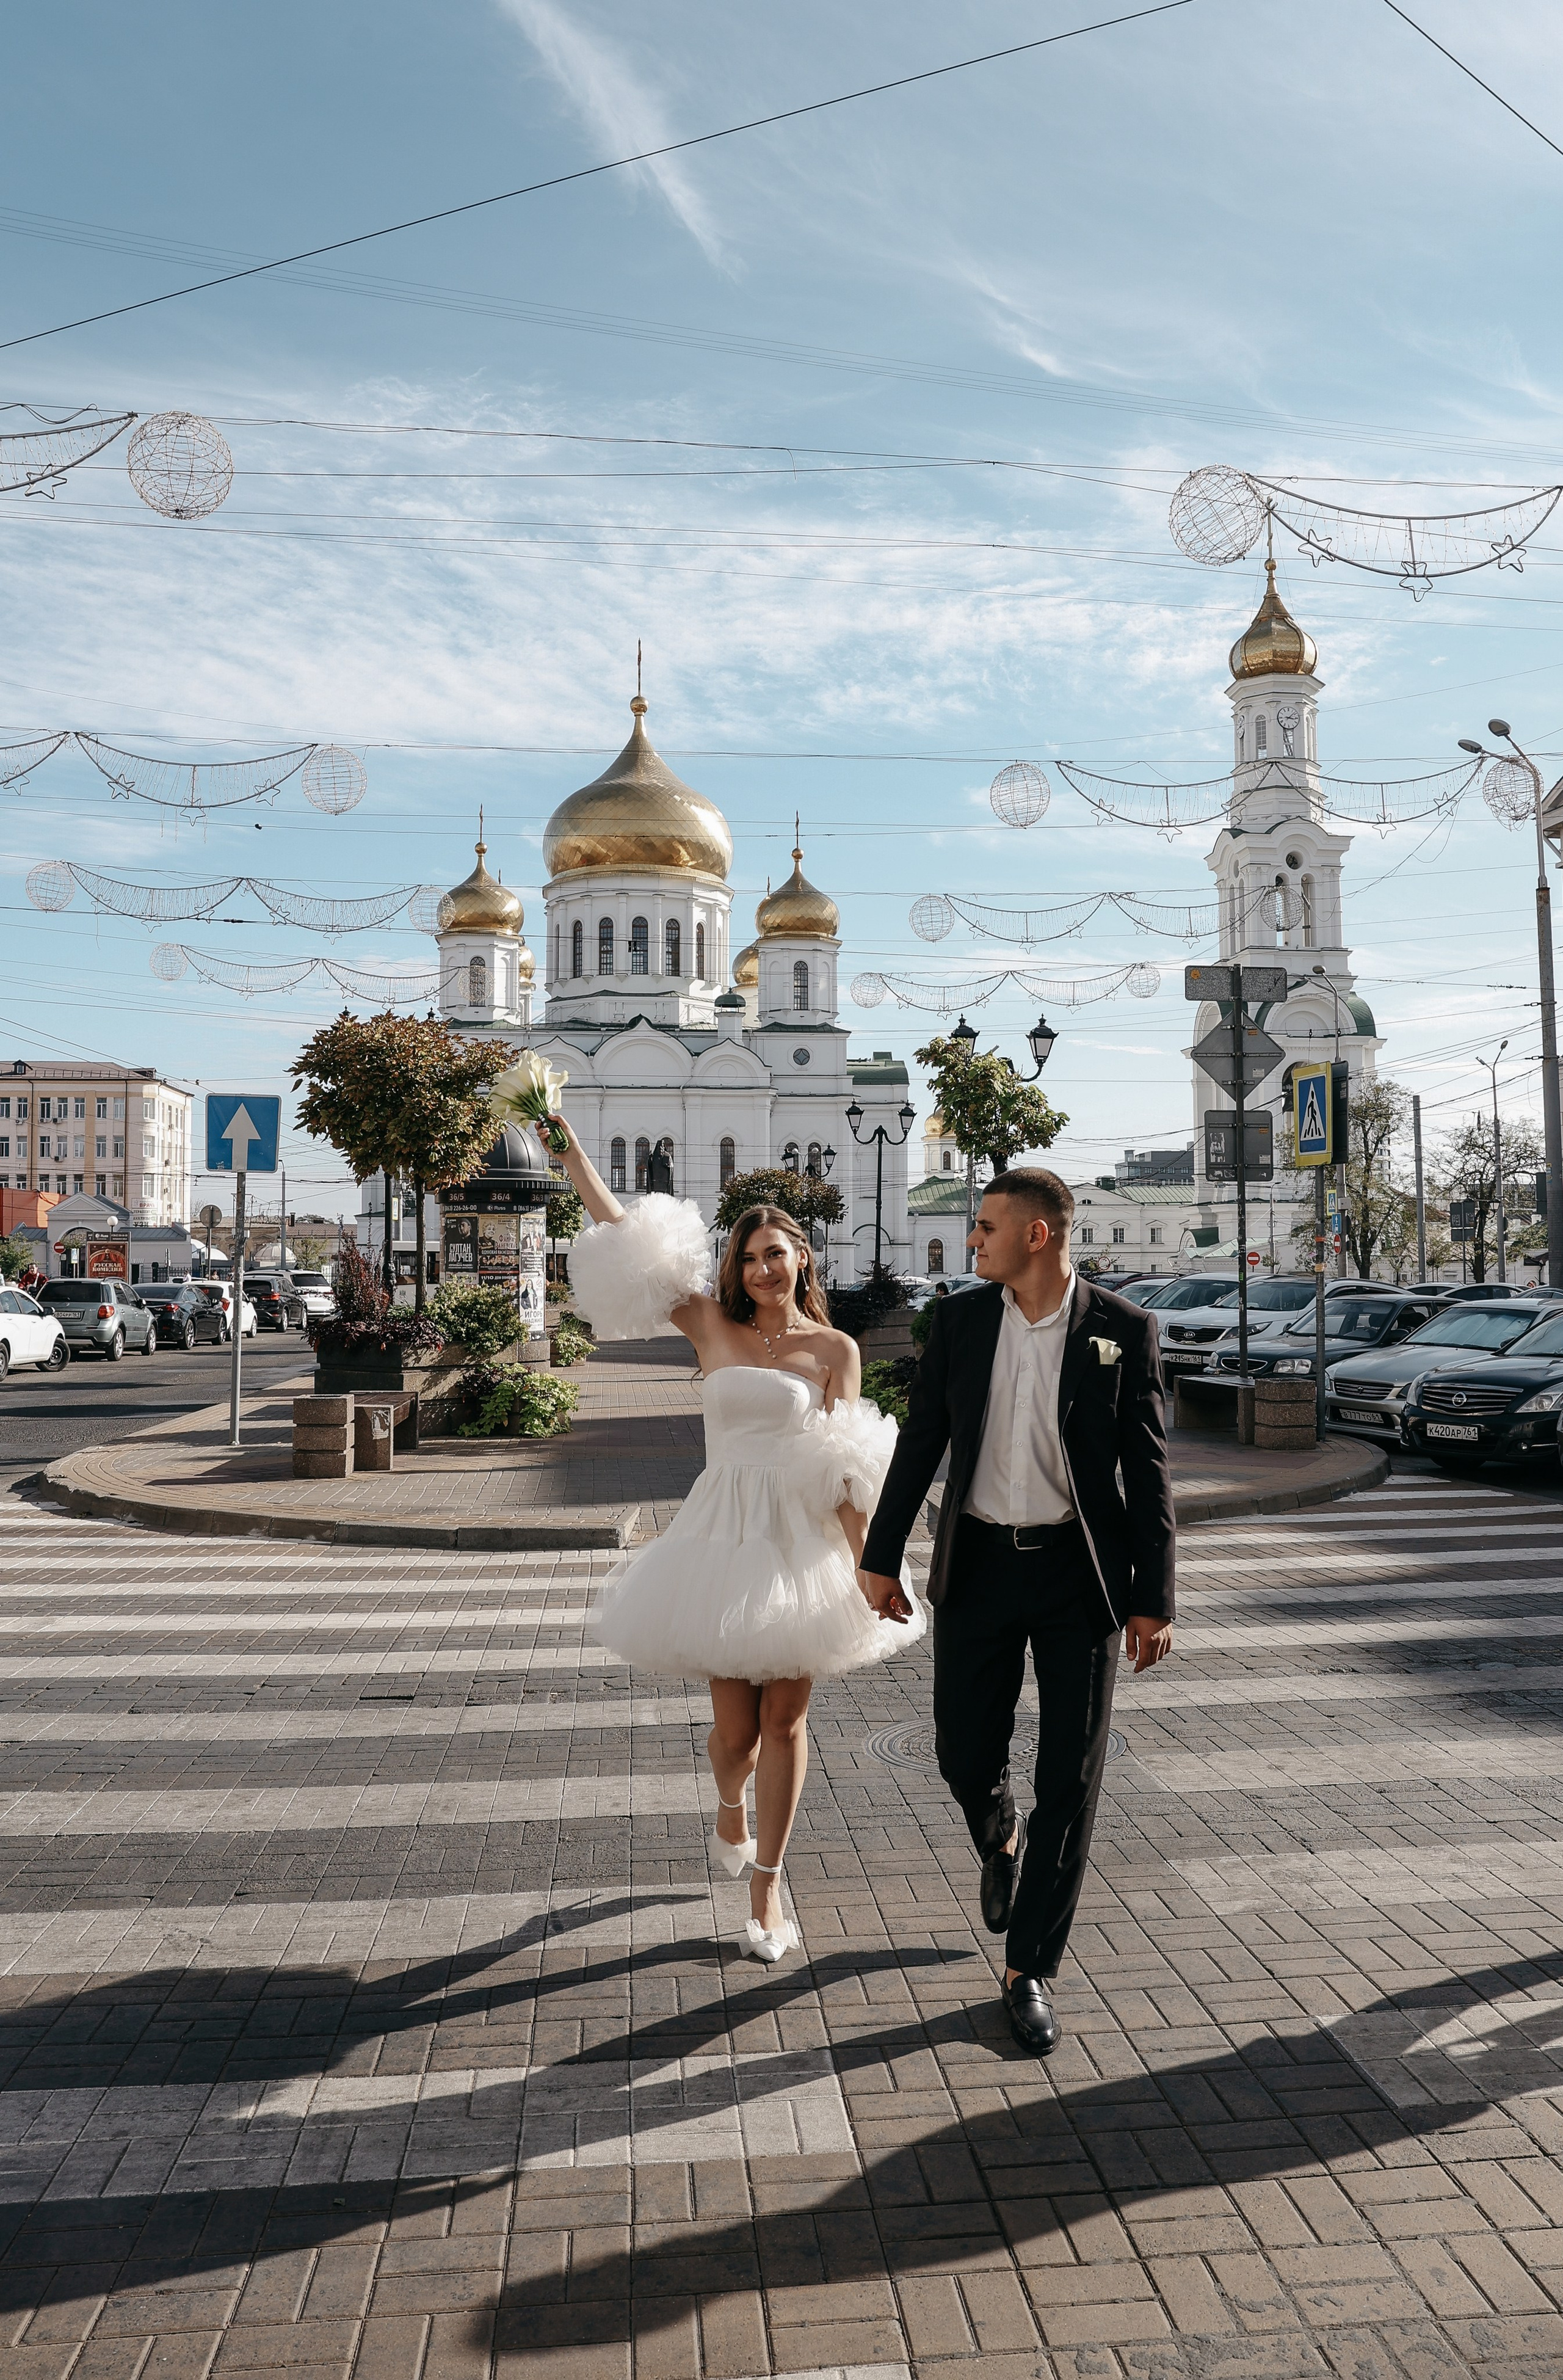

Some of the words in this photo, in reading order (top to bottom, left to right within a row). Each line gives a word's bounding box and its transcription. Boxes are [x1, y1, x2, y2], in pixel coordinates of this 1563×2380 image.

[449, 1243, 471, 1253] СУЛТАН
[448, 1253, 473, 1262] ЛАГУЧЕВ
[1170, 1354, 1191, 1363] К215НК
[1343, 1410, 1372, 1421] В777ТО
[1429, 1425, 1462, 1438] К420АР
[1462, 1427, 1477, 1436] 761
